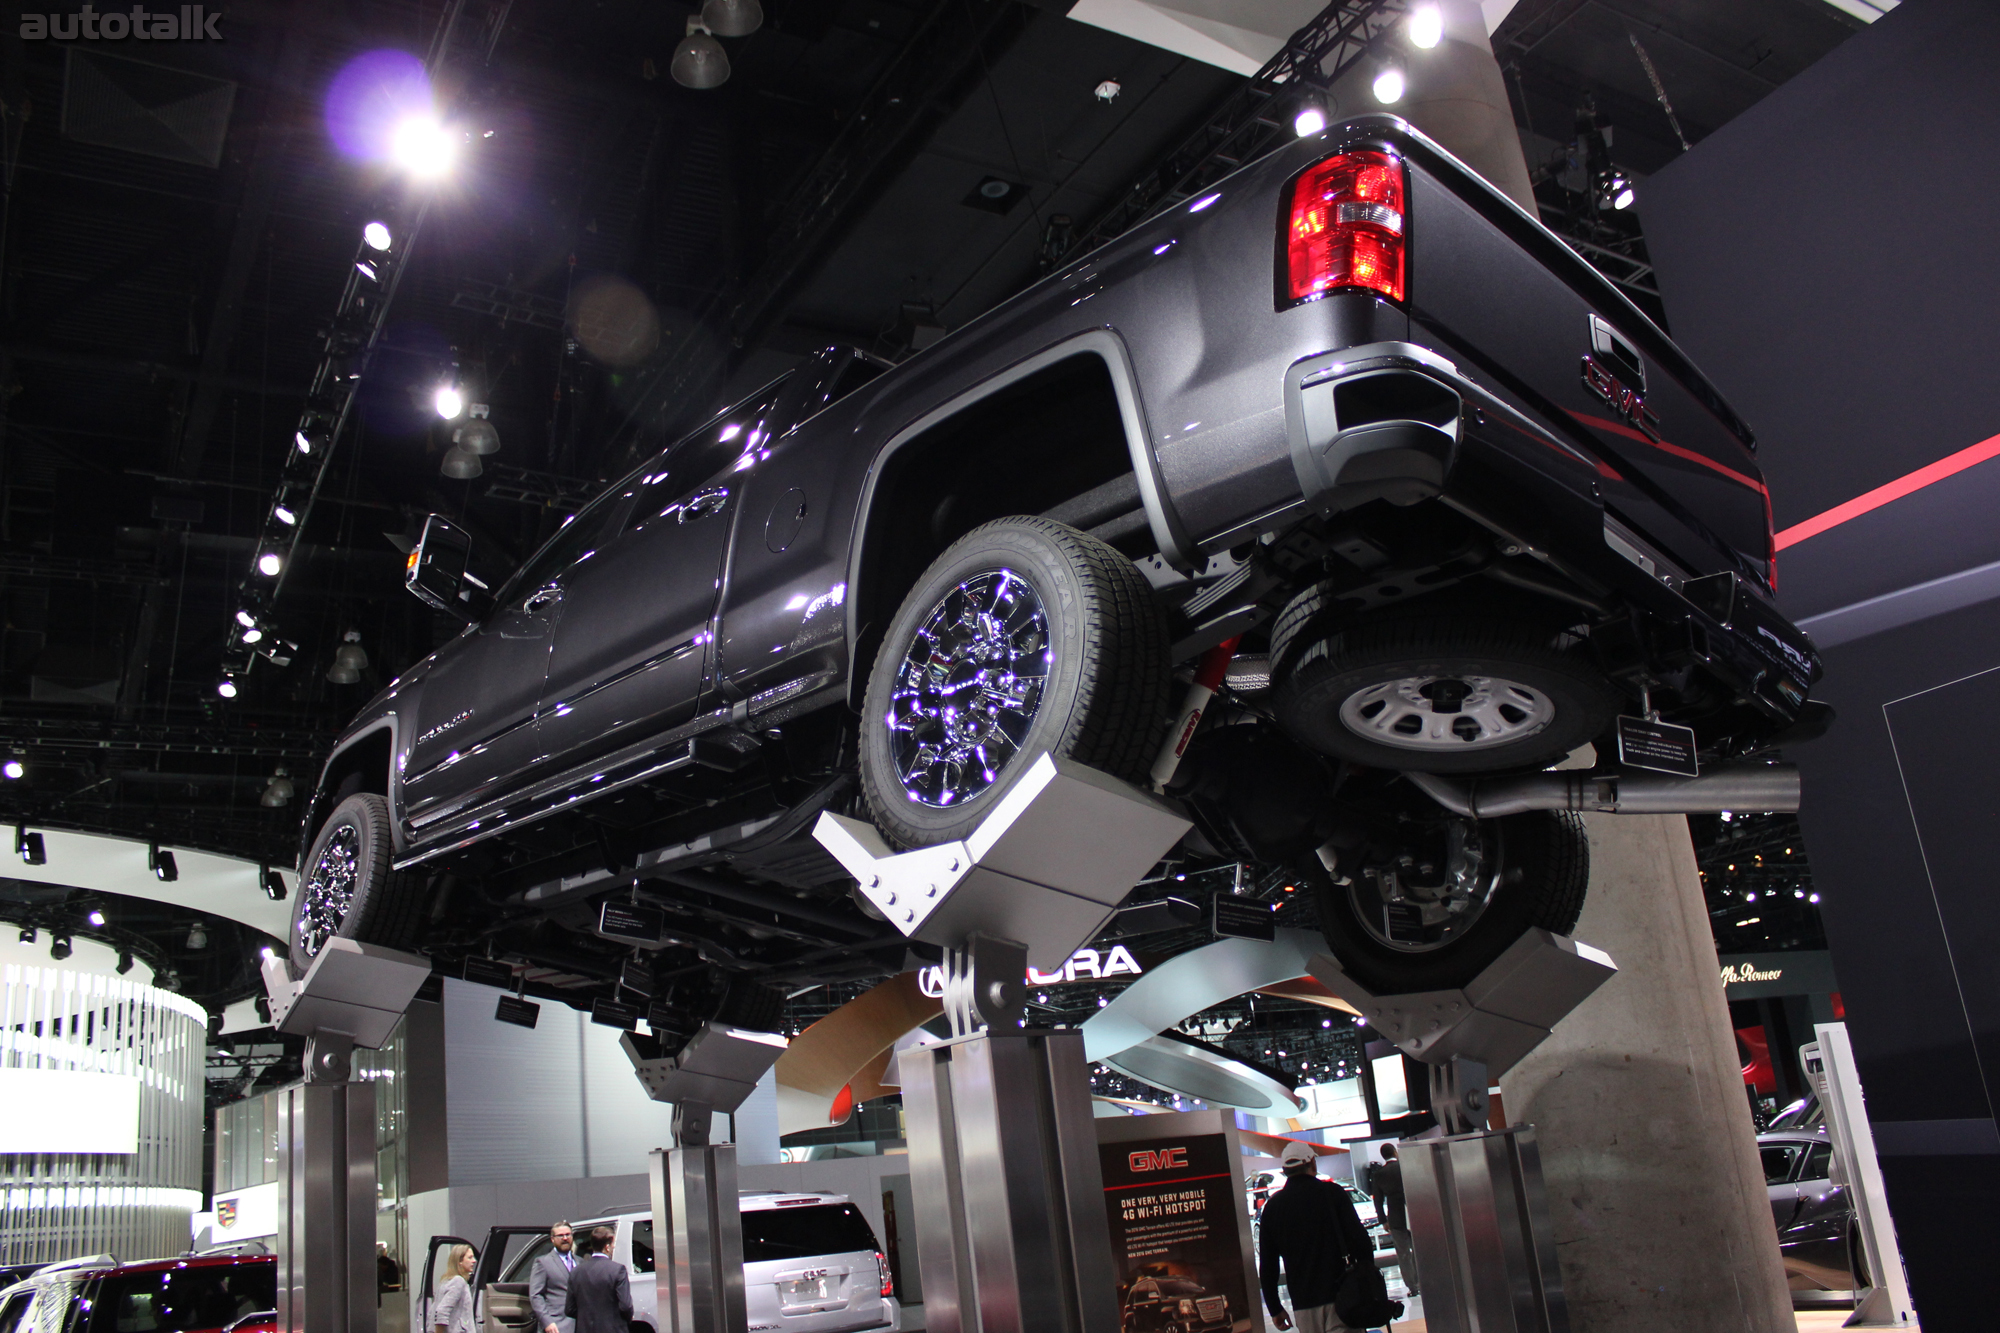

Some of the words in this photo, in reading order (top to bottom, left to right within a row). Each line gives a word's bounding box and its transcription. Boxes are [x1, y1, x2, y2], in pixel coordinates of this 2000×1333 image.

[1581, 355, 1661, 443] GMC
[1740, 961, 1782, 982] Romeo
[1128, 1147, 1189, 1172] GMC
[1121, 1198, 1136, 1208] ONE
[1137, 1196, 1158, 1206] VERY,
[1159, 1193, 1177, 1203] VERY
[1179, 1189, 1205, 1200] MOBILE
[1123, 1209, 1135, 1220] 4G
[1137, 1205, 1163, 1218] WI-FI
[1165, 1199, 1206, 1215] HOTSPOT
